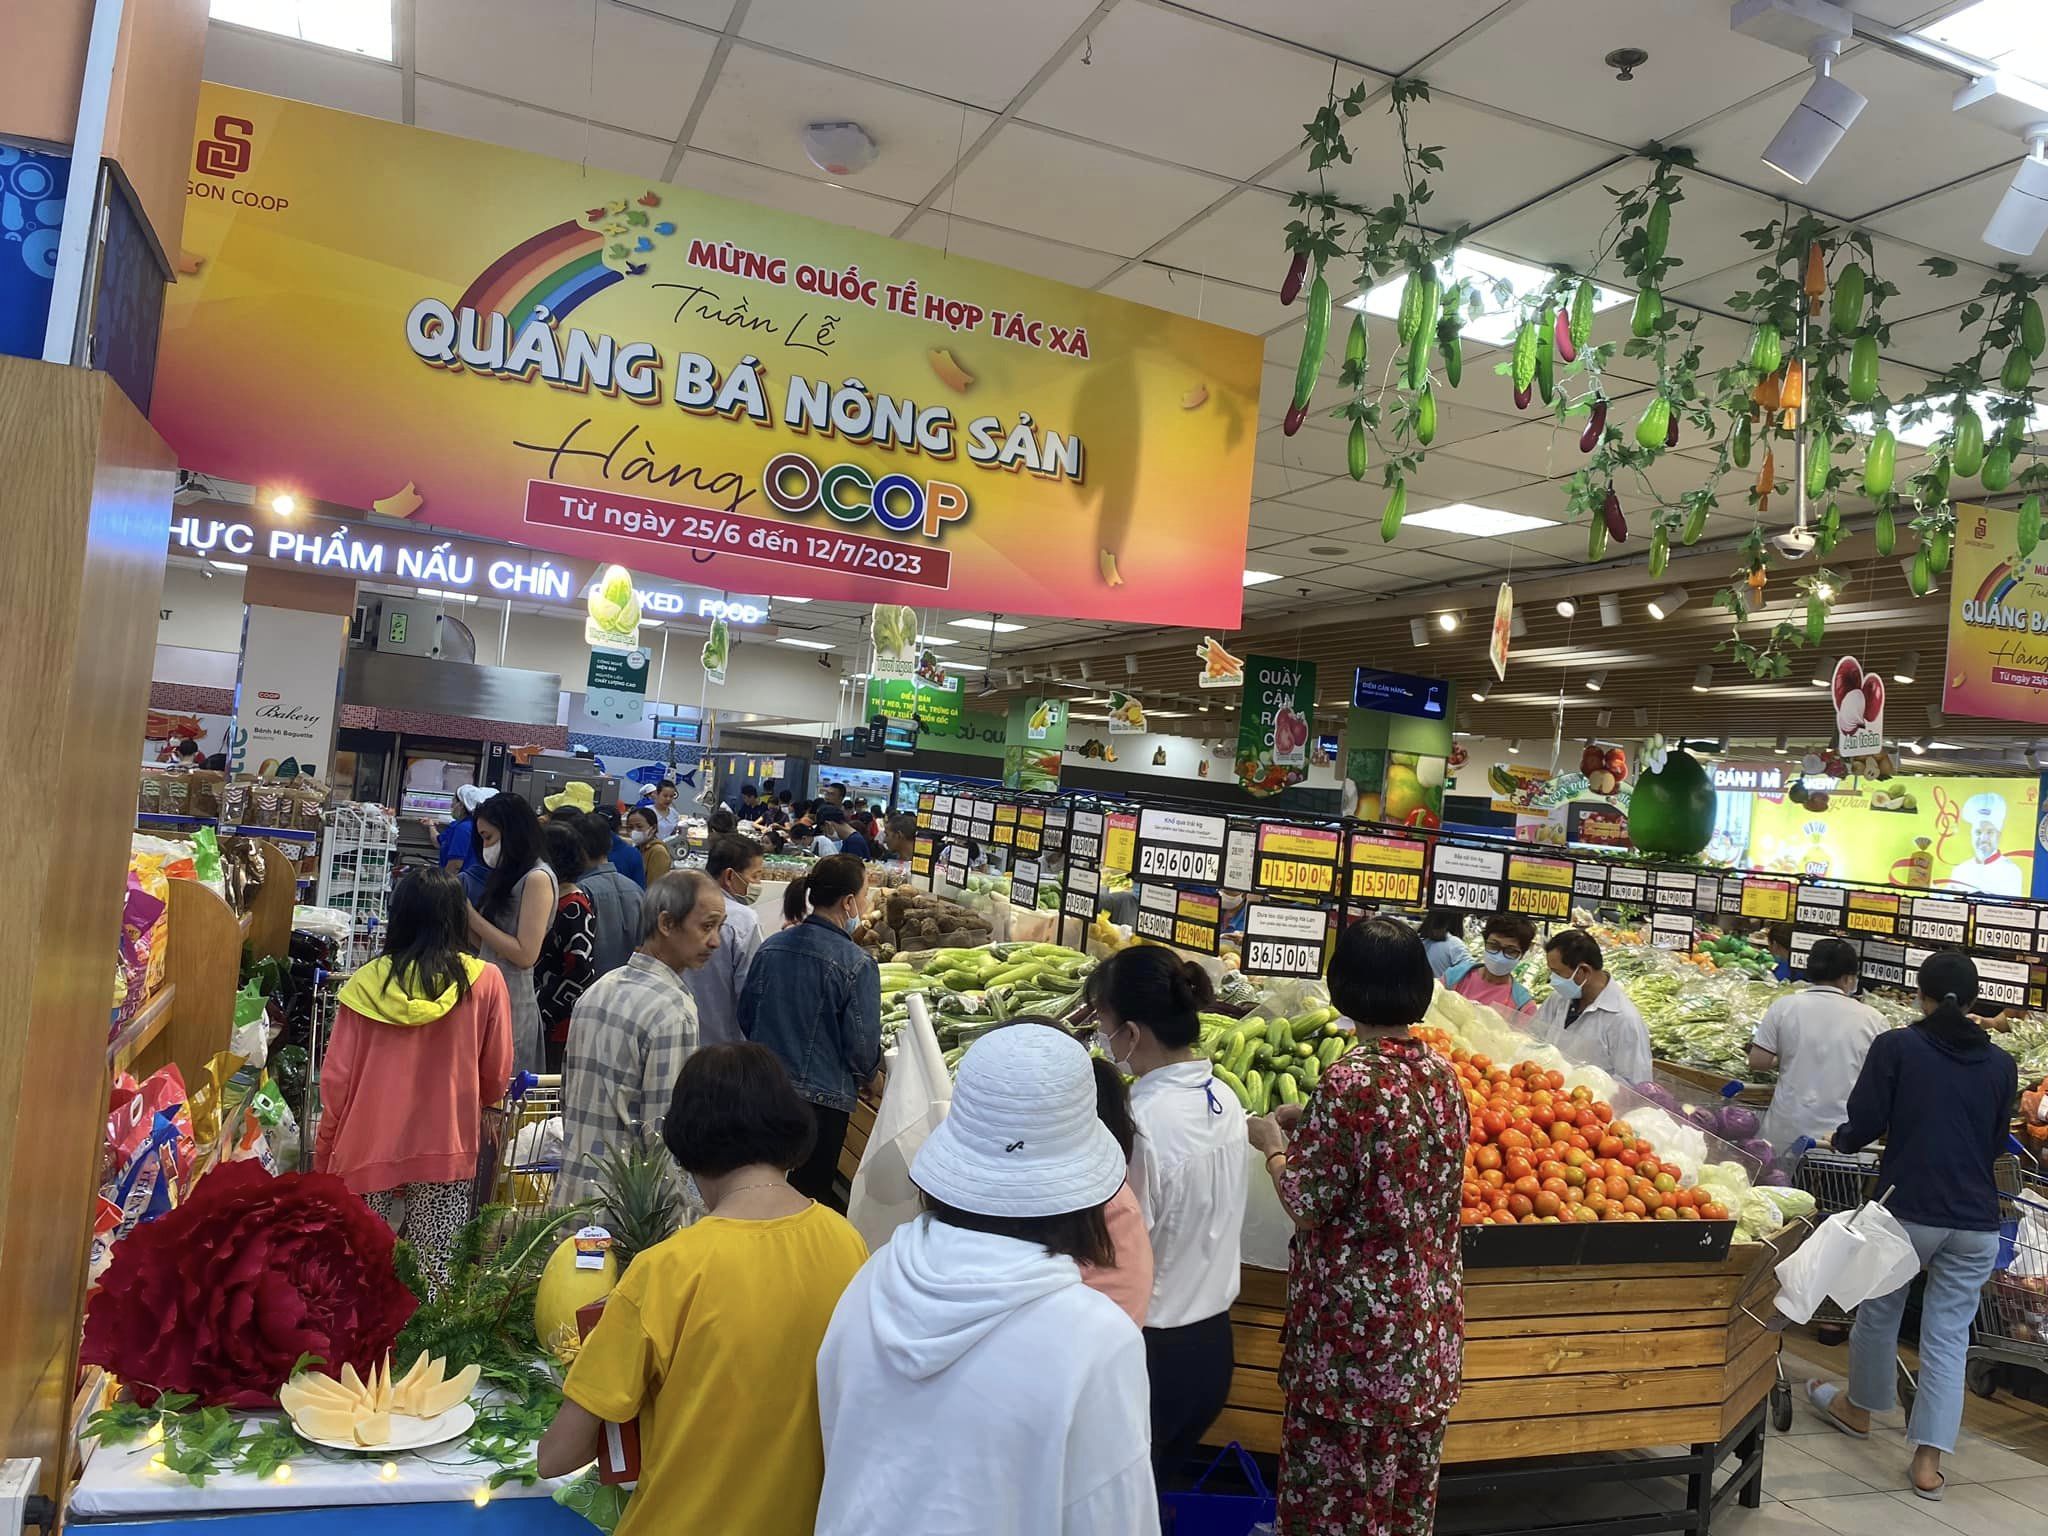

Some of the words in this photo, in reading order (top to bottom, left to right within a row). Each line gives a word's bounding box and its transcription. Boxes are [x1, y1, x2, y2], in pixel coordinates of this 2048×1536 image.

[231, 189, 289, 212] CO.OP
[688, 239, 787, 285] MỪNG
[795, 265, 878, 307] QUỐC
[885, 279, 918, 317] TẾ
[924, 294, 984, 333] HỢP
[991, 308, 1044, 347] TÁC
[1048, 324, 1091, 360] XÃ
[652, 283, 779, 333] Tuần
[784, 313, 841, 356] Lễ
[406, 298, 661, 403] QUẢNG
[674, 352, 773, 427] BÁ
[784, 375, 956, 461] NÔNG
[966, 411, 1084, 485] SẢN
[513, 419, 757, 562] Hàng
[764, 452, 969, 537] OCOP
[560, 494, 597, 522] Từ
[604, 506, 676, 539] ngày
[682, 516, 741, 546] 25/6
[748, 527, 799, 555] đến
[805, 536, 921, 575] 12/7/2023
[269, 525, 383, 573] PHẨM
[396, 542, 474, 584] NẤU
[487, 562, 570, 598] CHÍN
[699, 598, 760, 624] FOOD
[1961, 598, 2027, 632] QUẢNG
[1259, 666, 1302, 688] QUẦY
[2012, 673, 2030, 686] ngày
[255, 703, 320, 729] Bakery
[1843, 734, 1858, 750] An
[1859, 730, 1880, 748] toàn
[1714, 768, 1757, 787] BÁNH
[1143, 850, 1204, 875] 29.600
[1264, 862, 1319, 885] 11.500
[1355, 874, 1406, 894] 15.500
[1437, 882, 1486, 904] 39.900
[1511, 891, 1557, 911] 26.500
[1252, 945, 1306, 967] 36.500
